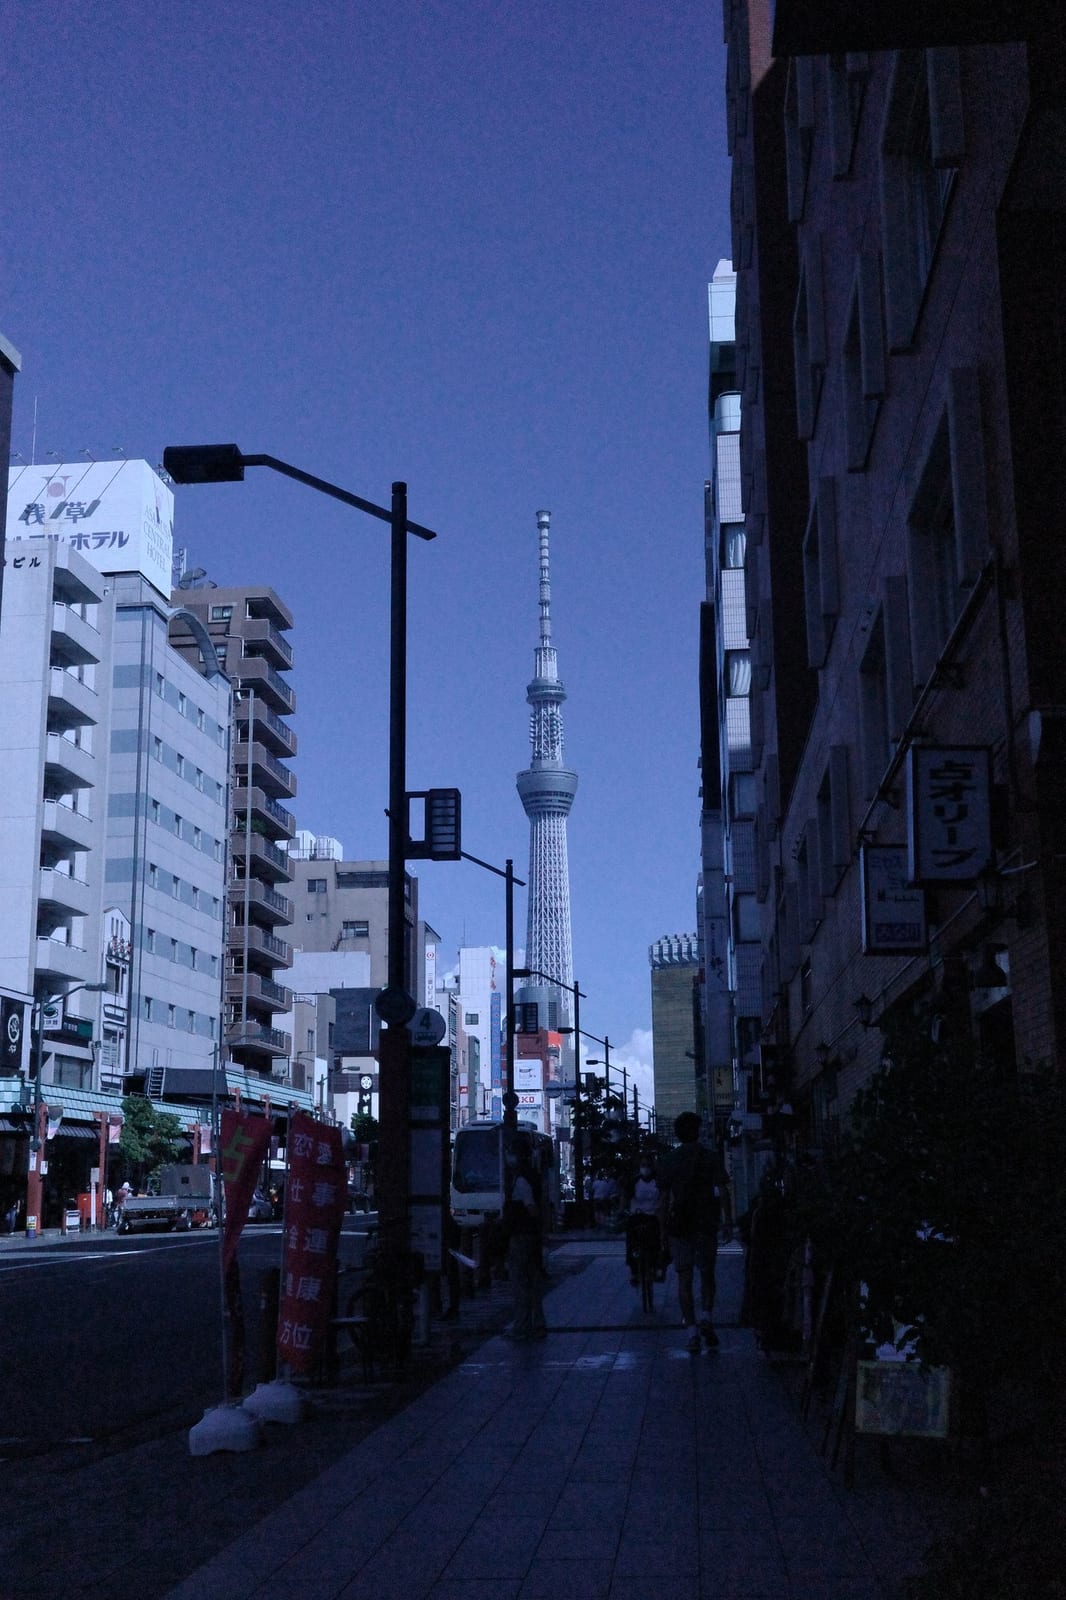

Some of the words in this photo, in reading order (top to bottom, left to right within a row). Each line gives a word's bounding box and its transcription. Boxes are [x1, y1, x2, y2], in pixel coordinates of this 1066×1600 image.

[22, 503, 87, 526] 浅草
[419, 1011, 432, 1030] 4
[293, 1133, 333, 1163] 恋愛
[289, 1178, 338, 1208] 仕事
